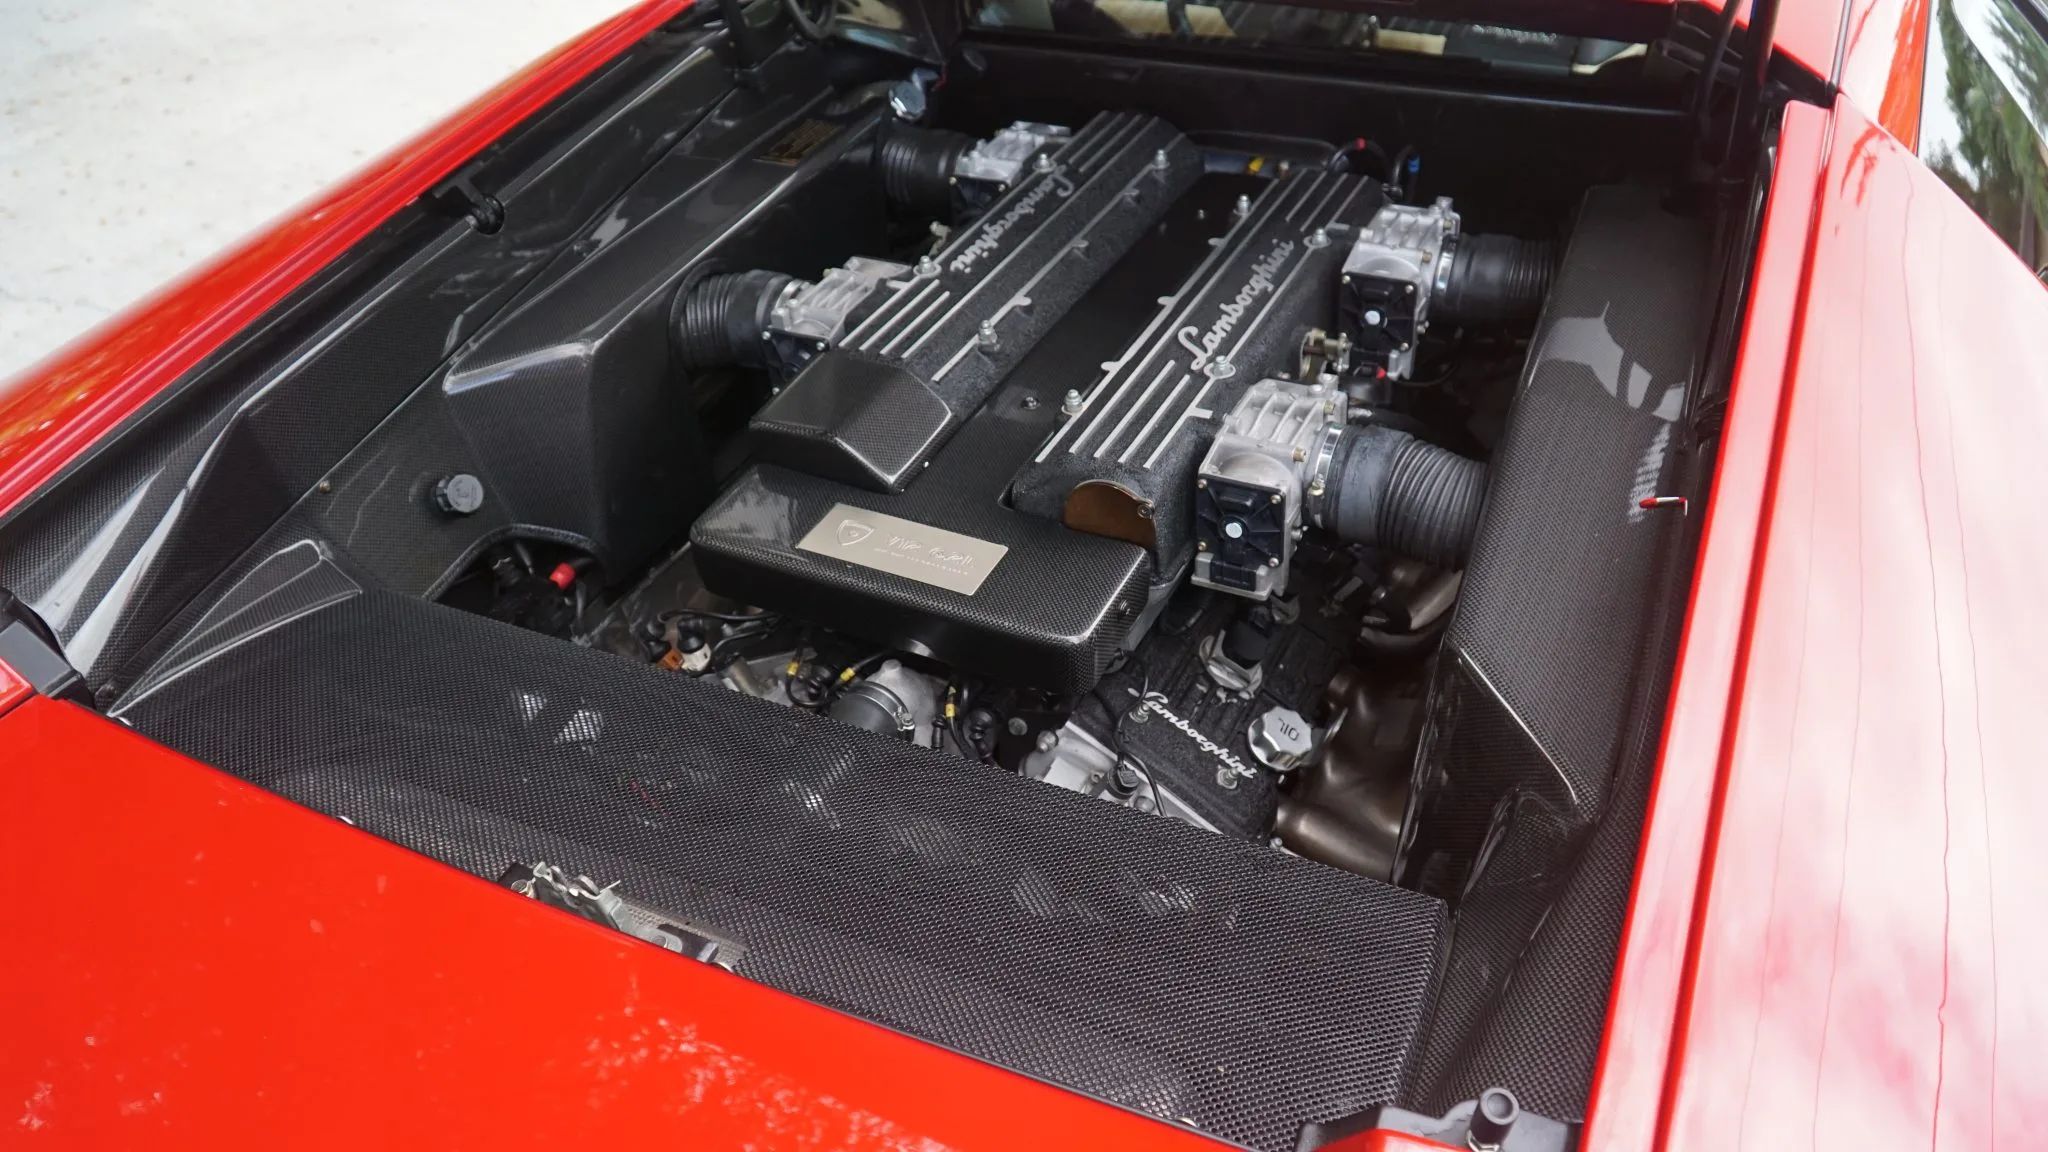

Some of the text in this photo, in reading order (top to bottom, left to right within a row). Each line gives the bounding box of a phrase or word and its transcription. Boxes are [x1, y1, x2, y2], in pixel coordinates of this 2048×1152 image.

[950, 165, 1075, 273] Lamborghini
[1178, 239, 1294, 370] Lamborghini
[1127, 688, 1257, 779] Lamborghini
[1279, 718, 1300, 741] OIL
